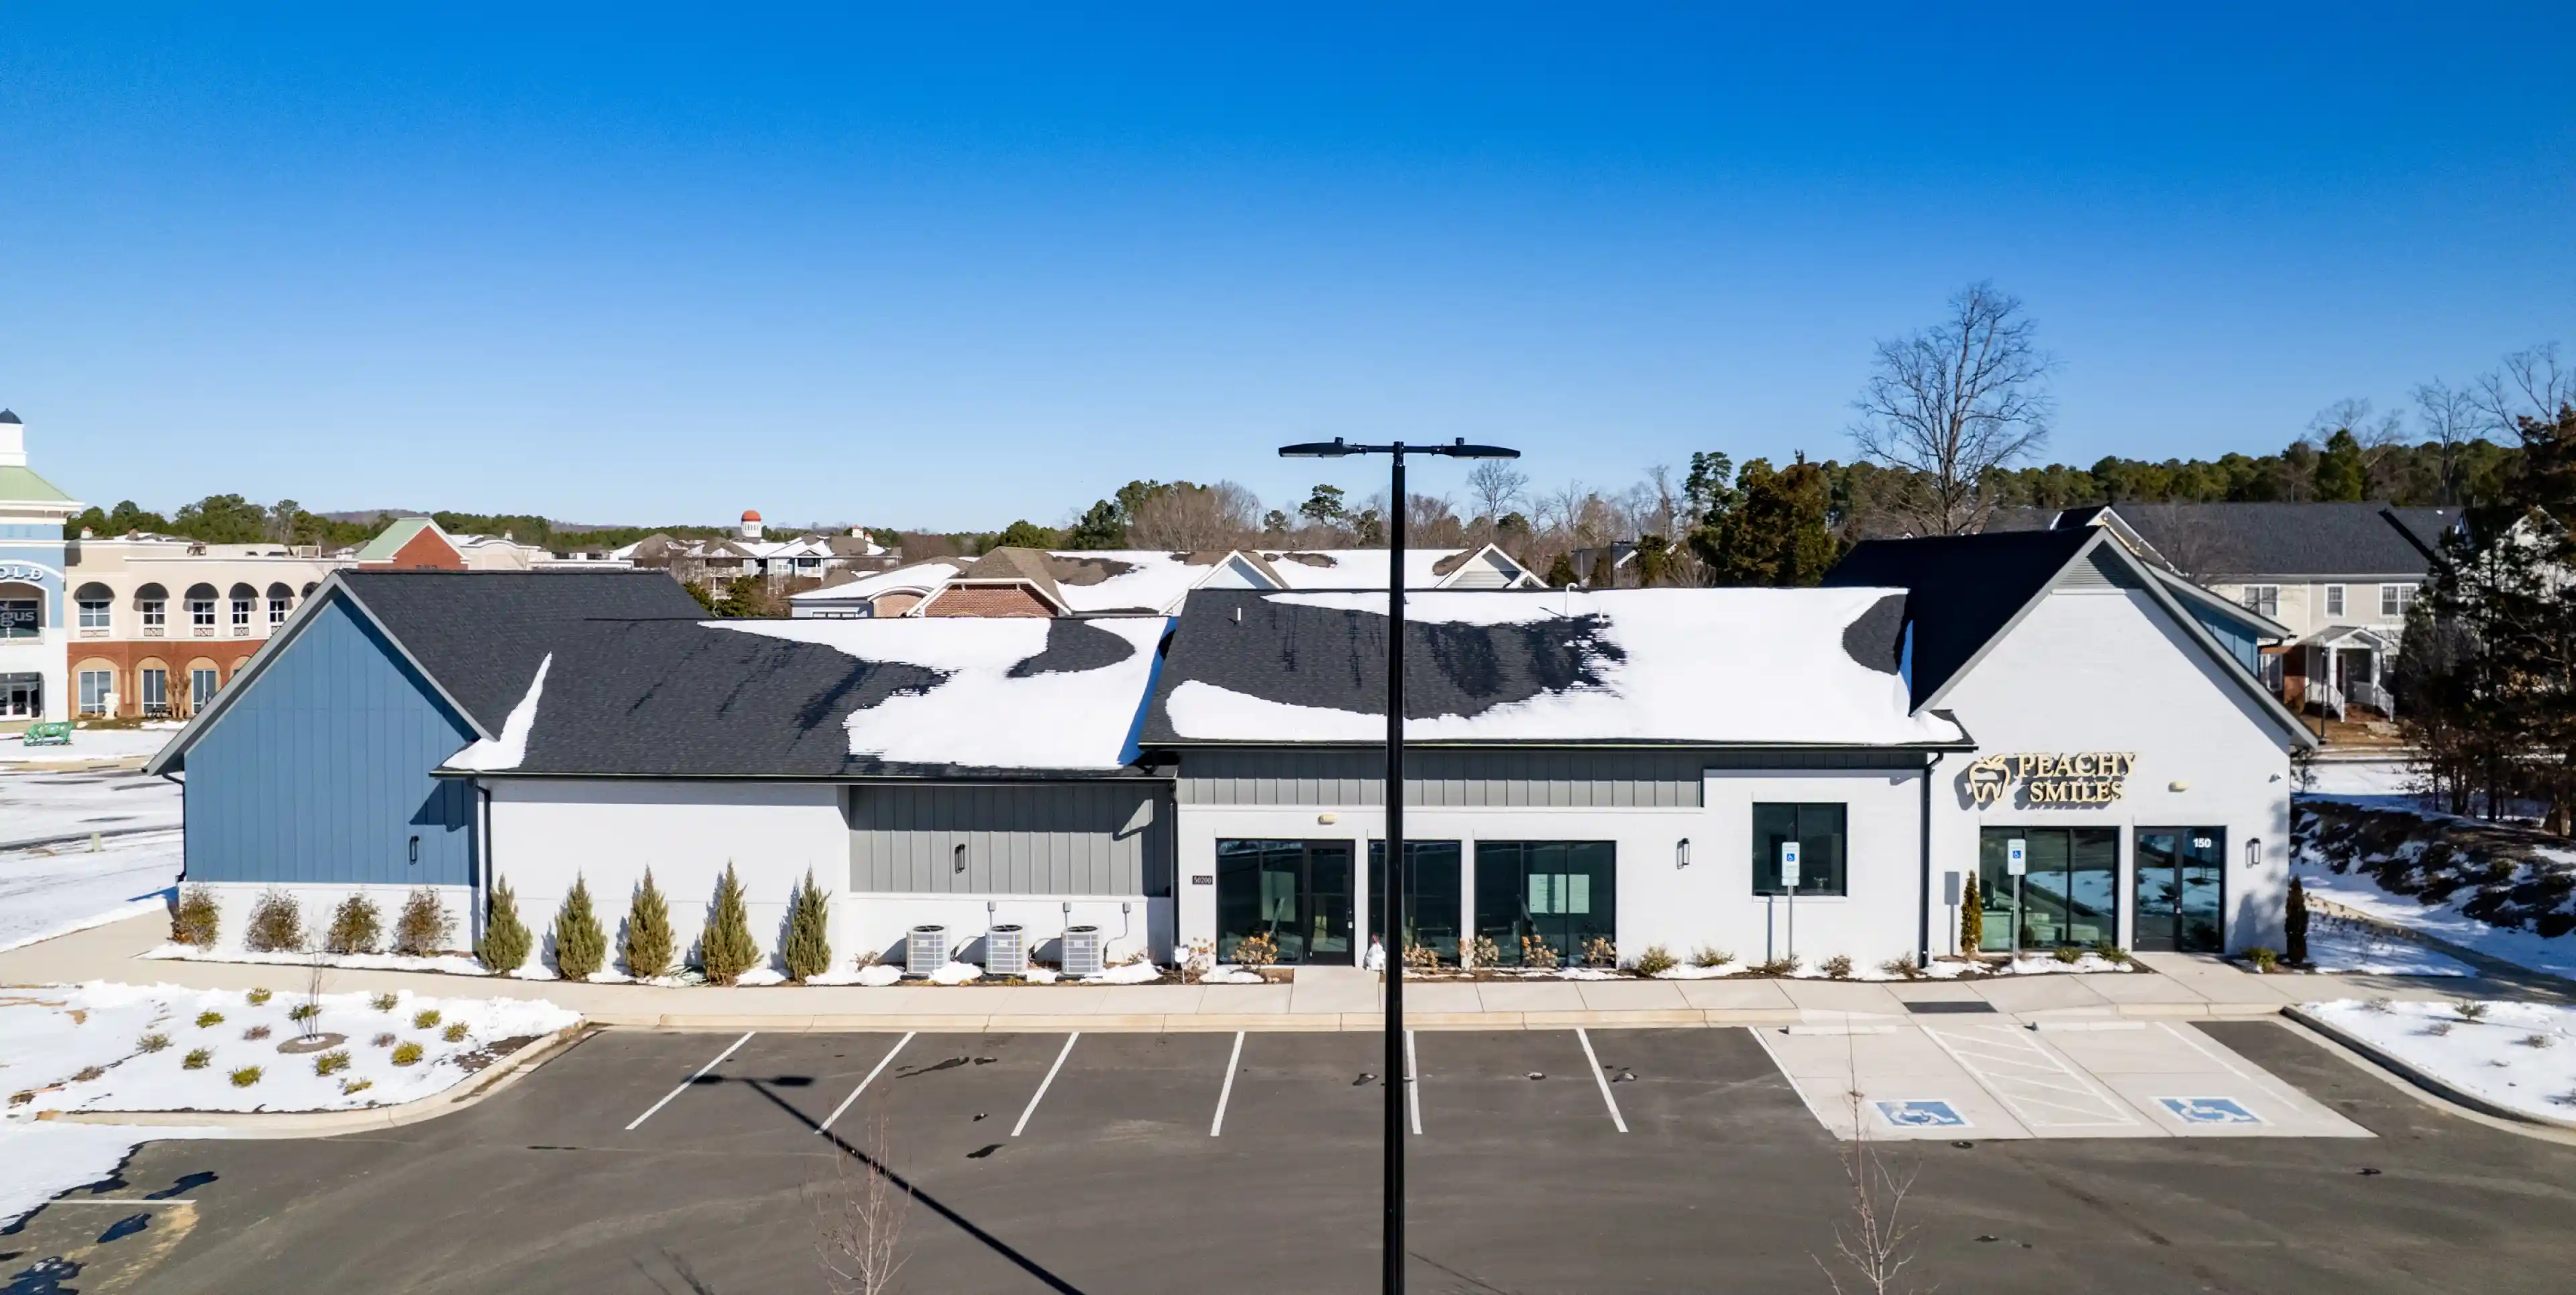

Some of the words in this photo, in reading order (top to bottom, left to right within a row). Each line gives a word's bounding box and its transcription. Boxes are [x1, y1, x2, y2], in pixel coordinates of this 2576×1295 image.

[2015, 752, 2136, 778] PEACHY
[2029, 781, 2125, 802] SMILES
[2193, 837, 2212, 848] 150
